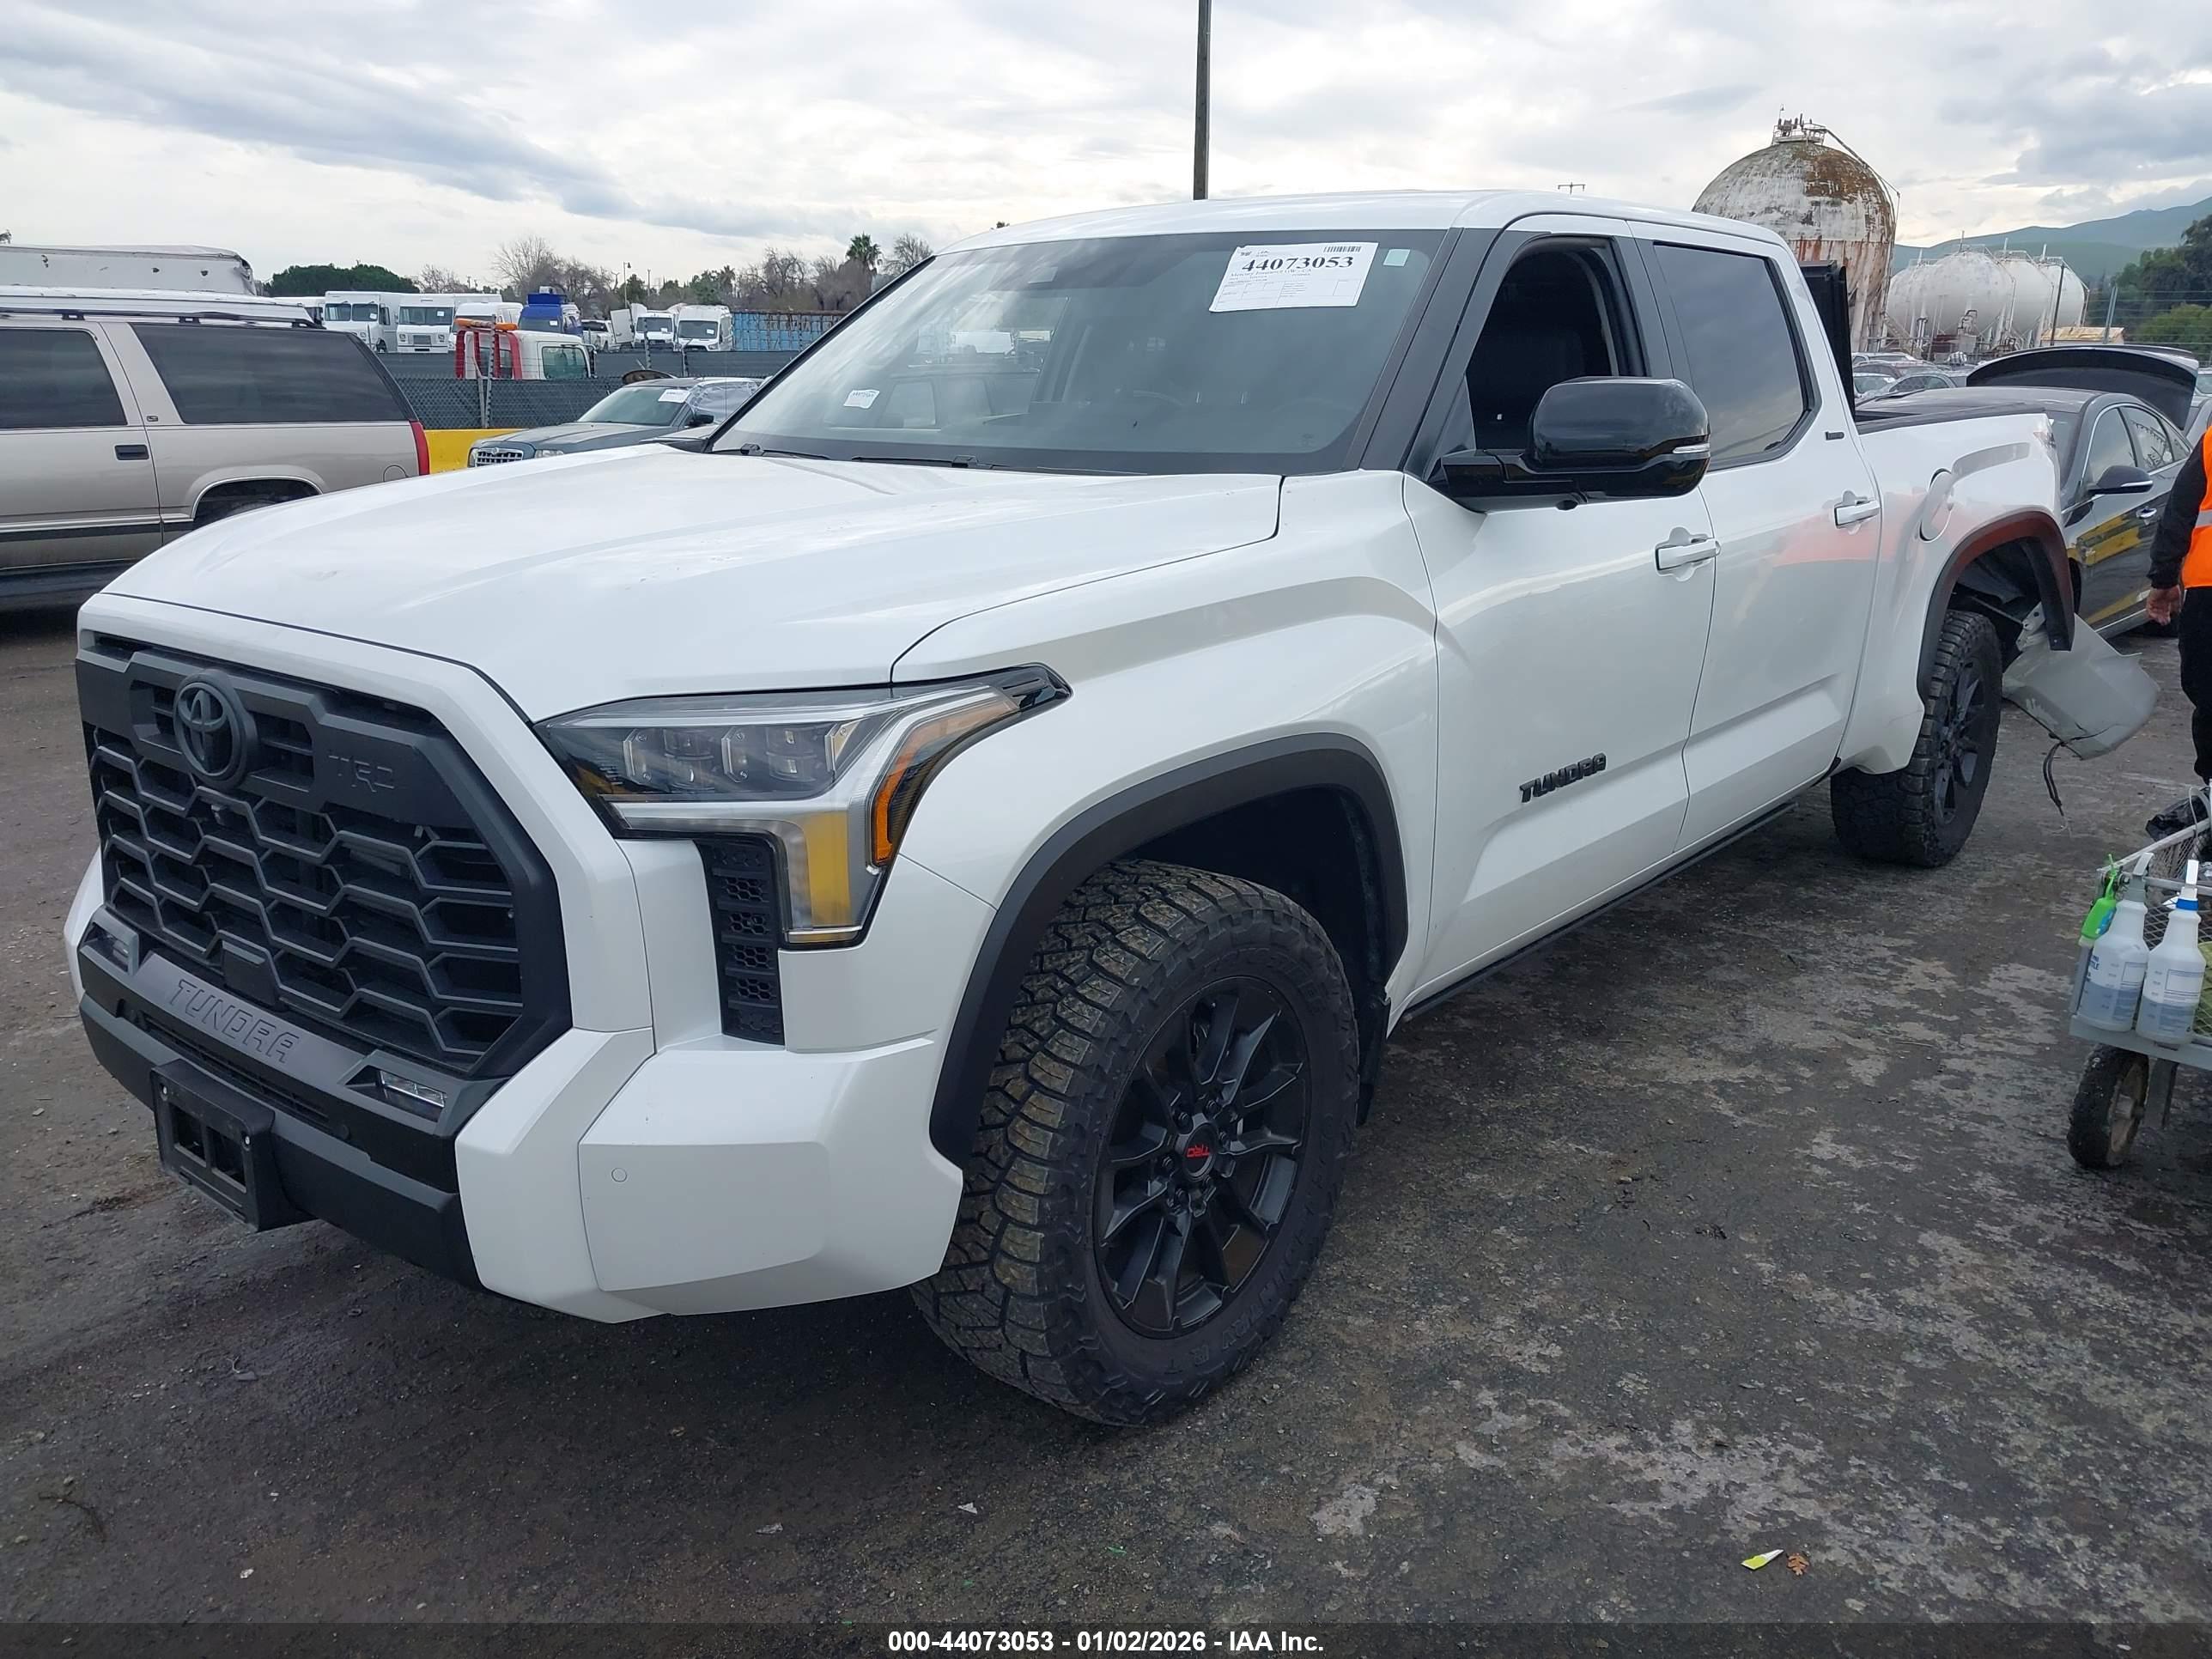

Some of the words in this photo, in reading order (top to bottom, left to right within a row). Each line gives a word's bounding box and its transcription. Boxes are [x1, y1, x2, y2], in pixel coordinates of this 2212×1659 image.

[1243, 257, 1353, 271] 44073053
[327, 752, 396, 793] TRD
[1519, 752, 1607, 804] TUNDRA
[169, 978, 300, 1064] TUNDRA
